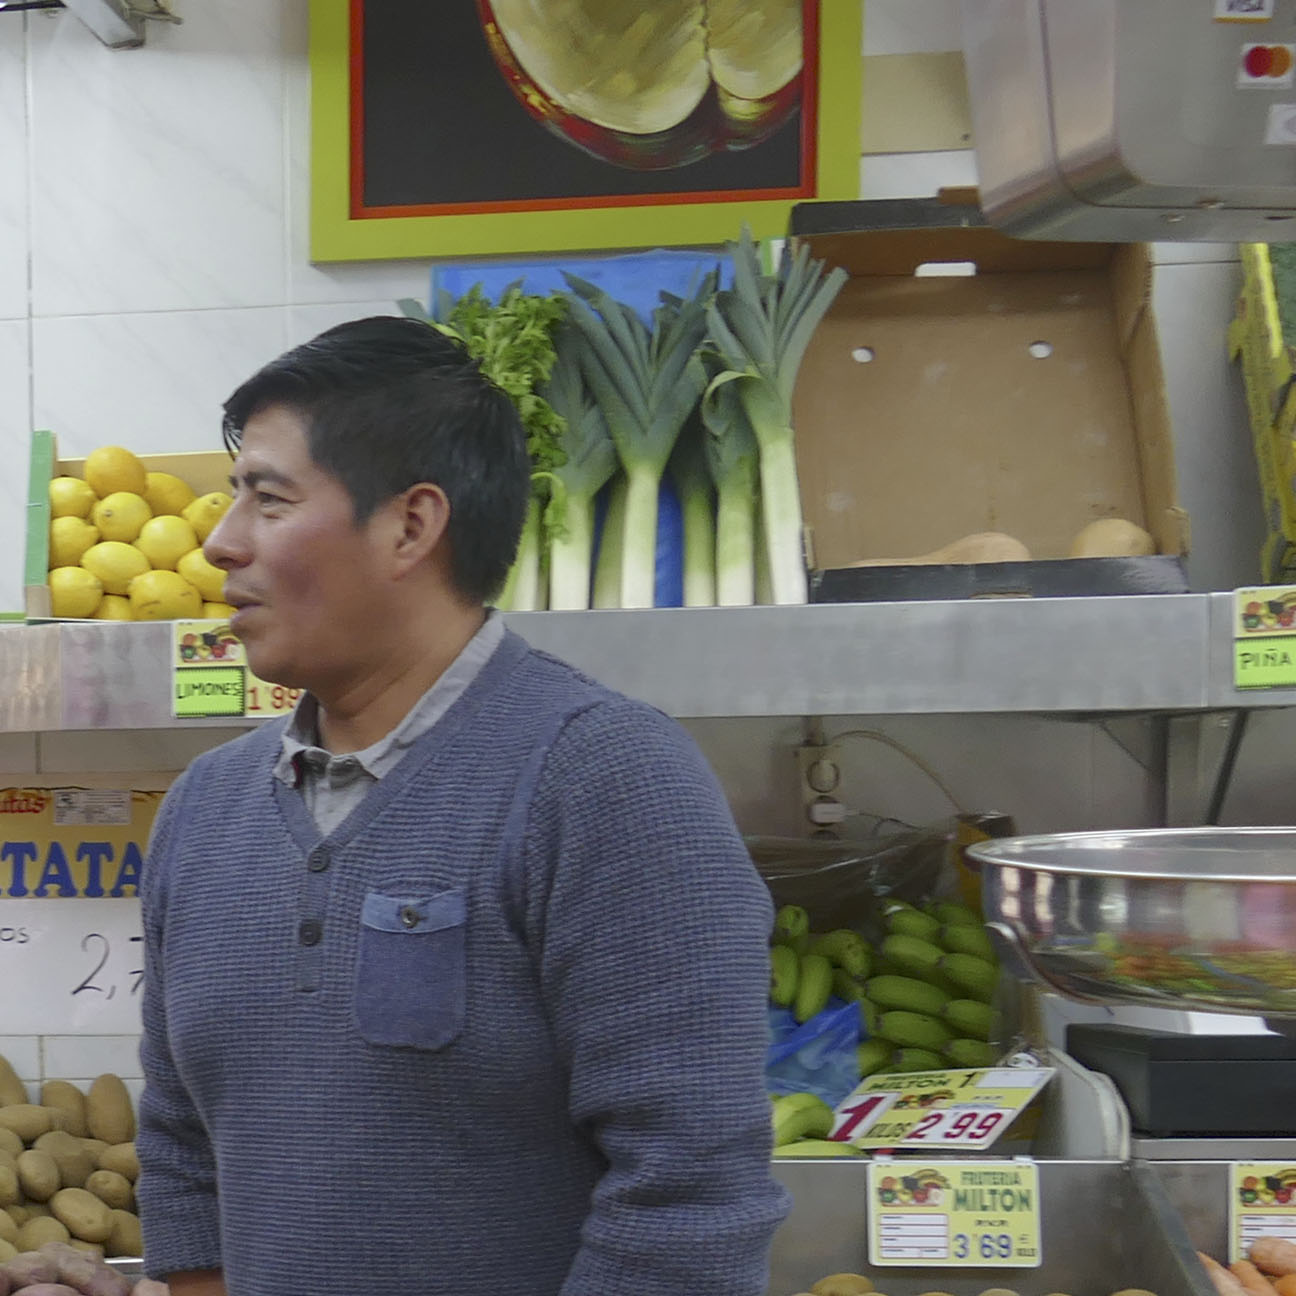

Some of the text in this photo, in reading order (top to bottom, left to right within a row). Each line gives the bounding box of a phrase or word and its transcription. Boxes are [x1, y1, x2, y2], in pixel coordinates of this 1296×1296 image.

[1239, 647, 1292, 671] PIÑA
[175, 682, 242, 699] LIMONES
[868, 1078, 952, 1091] MILTON
[828, 1096, 886, 1142] 1
[960, 1170, 1022, 1186] FRUTERIA
[953, 1188, 1032, 1212] MILTON
